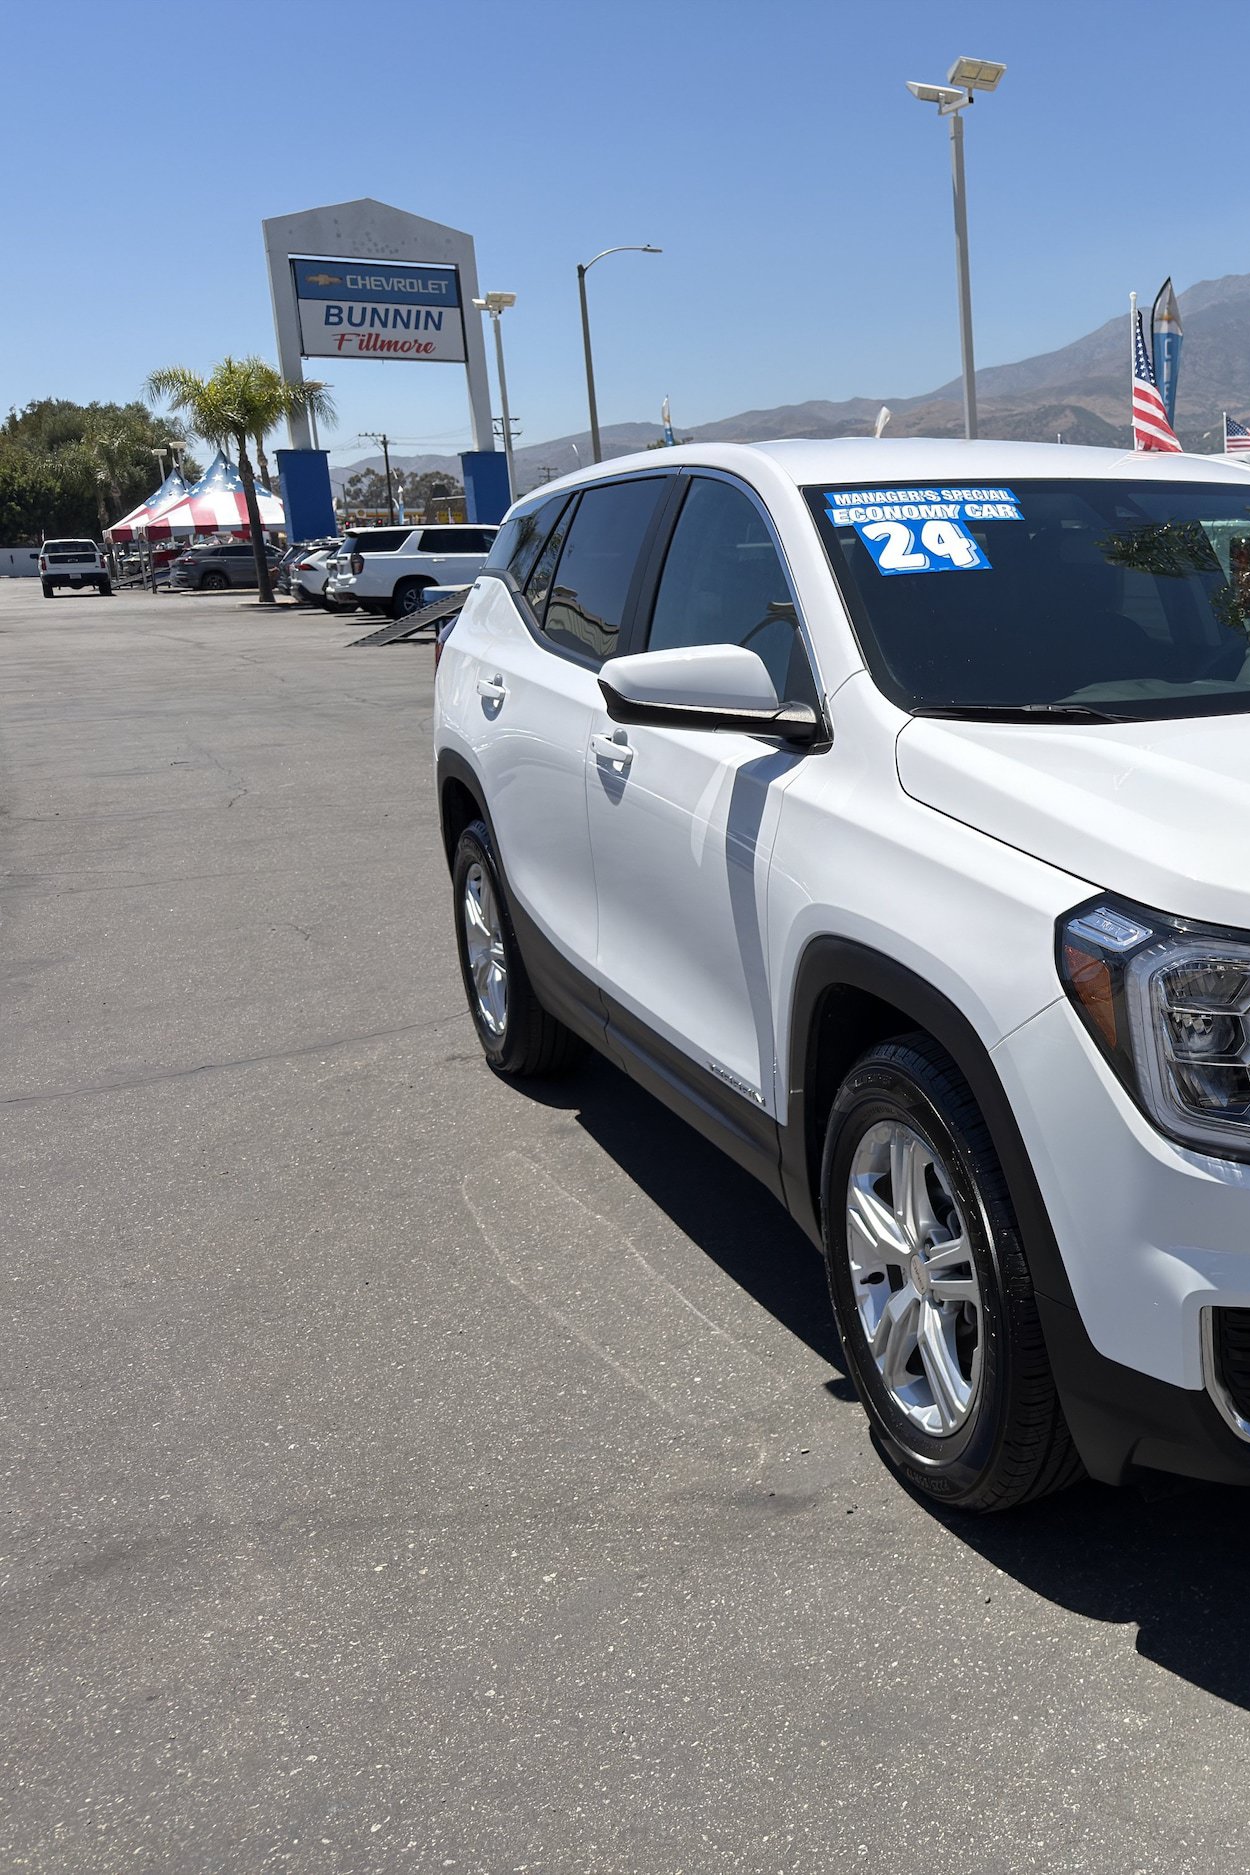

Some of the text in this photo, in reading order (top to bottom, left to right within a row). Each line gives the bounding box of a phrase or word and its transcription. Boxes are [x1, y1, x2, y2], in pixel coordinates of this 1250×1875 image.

[346, 275, 448, 294] CHEVROLET
[324, 304, 443, 331] BUNNIN
[331, 332, 436, 354] Fillmore
[833, 488, 1015, 505] MANAGER'S SPECIAL
[832, 504, 1019, 524] ECONOMY CAR
[862, 520, 981, 570] 24
